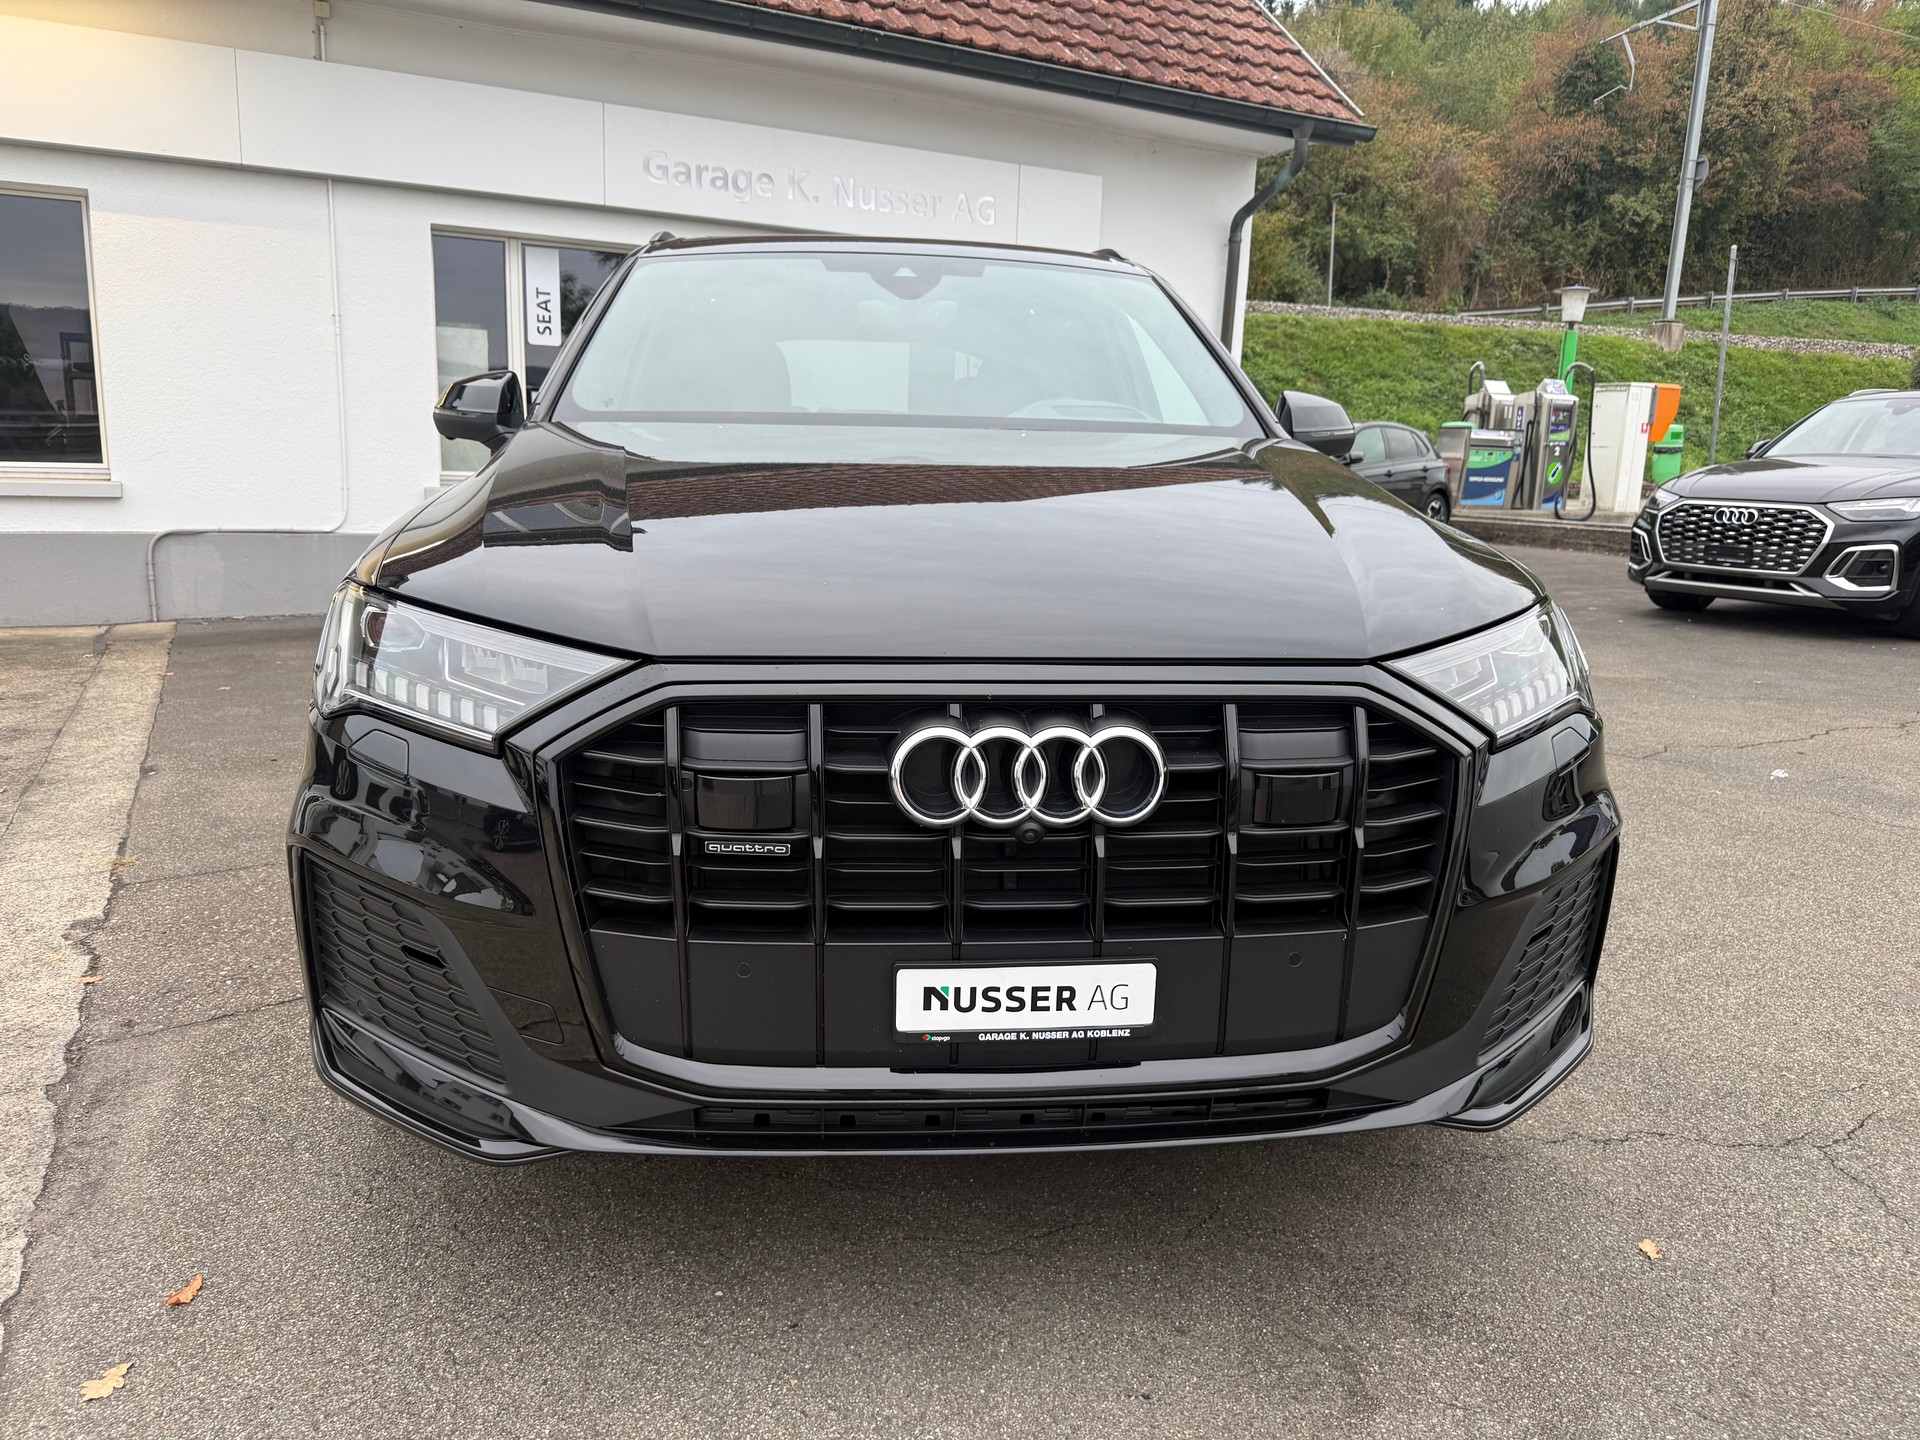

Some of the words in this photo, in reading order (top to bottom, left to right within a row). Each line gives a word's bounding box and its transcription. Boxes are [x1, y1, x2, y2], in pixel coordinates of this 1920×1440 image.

[642, 149, 775, 203] Garage
[787, 167, 820, 204] K.
[833, 174, 942, 220] Nusser
[950, 192, 998, 225] AG
[536, 287, 551, 335] SEAT
[1554, 446, 1560, 456] 2
[708, 844, 786, 853] quattro
[922, 985, 1077, 1013] NUSSER
[1087, 983, 1129, 1011] AG
[978, 1033, 1017, 1041] GARAGE
[1020, 1032, 1030, 1040] K.
[1032, 1031, 1070, 1040] NUSSER
[1071, 1030, 1085, 1039] AG
[1087, 1029, 1131, 1038] KOBLENZ
